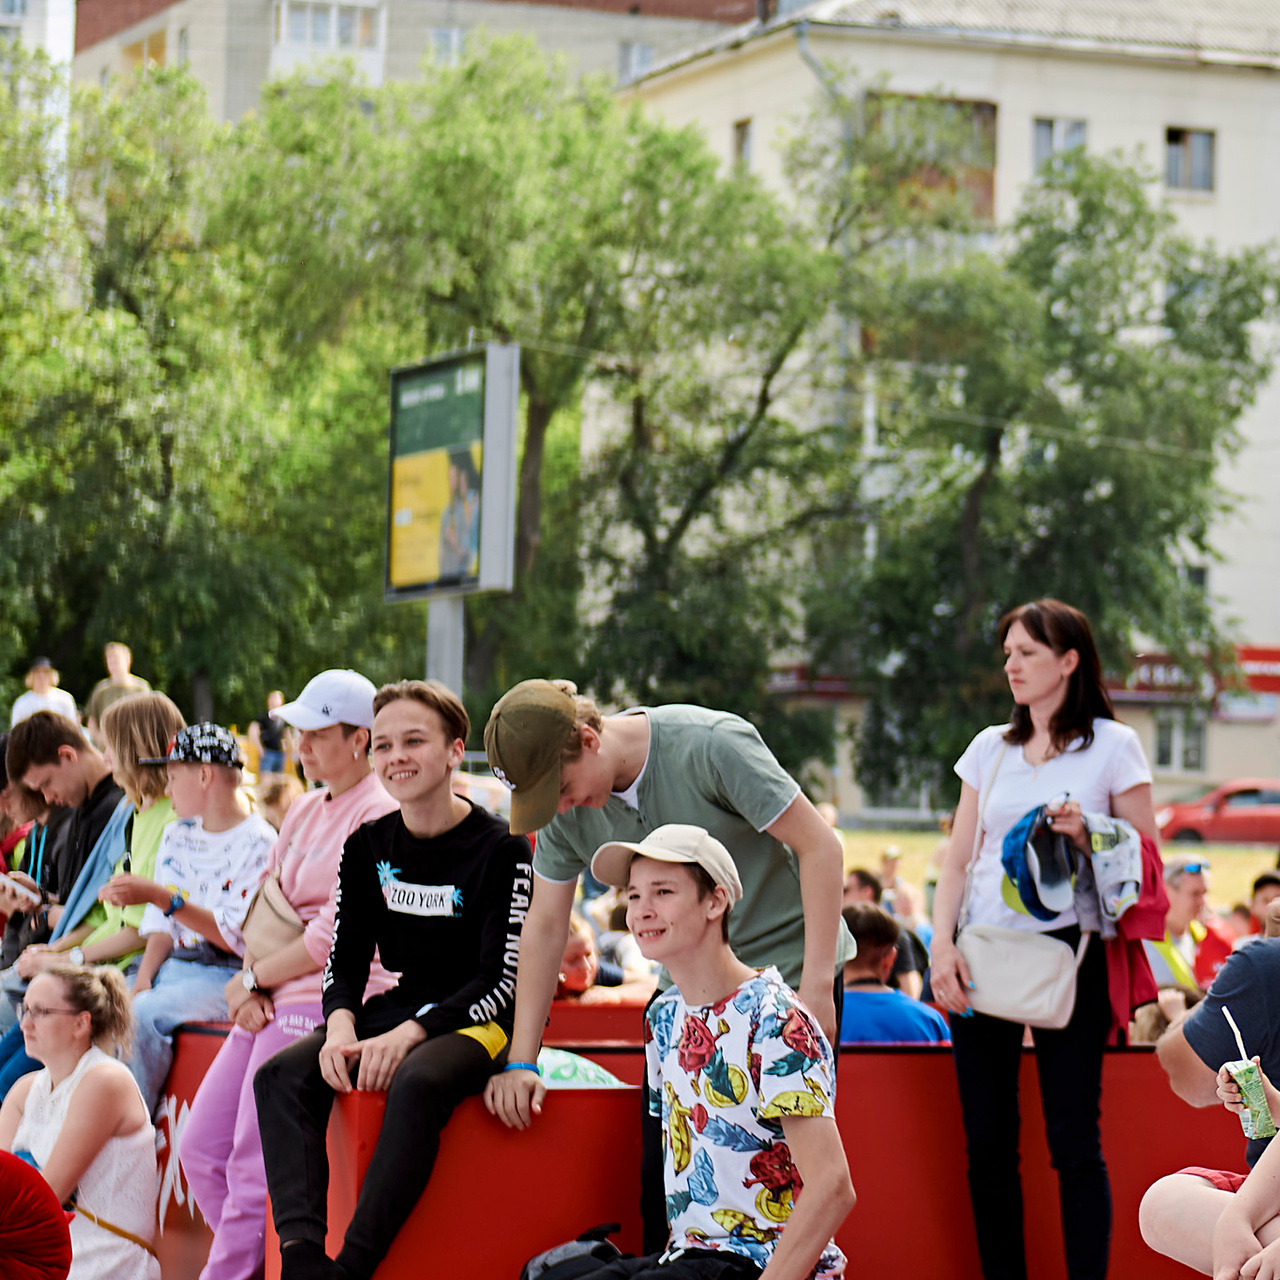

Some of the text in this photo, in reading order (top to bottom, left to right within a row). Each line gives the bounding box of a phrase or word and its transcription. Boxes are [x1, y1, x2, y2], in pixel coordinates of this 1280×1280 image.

[391, 887, 446, 909] ZOO YORK
[508, 862, 533, 925] FEAR
